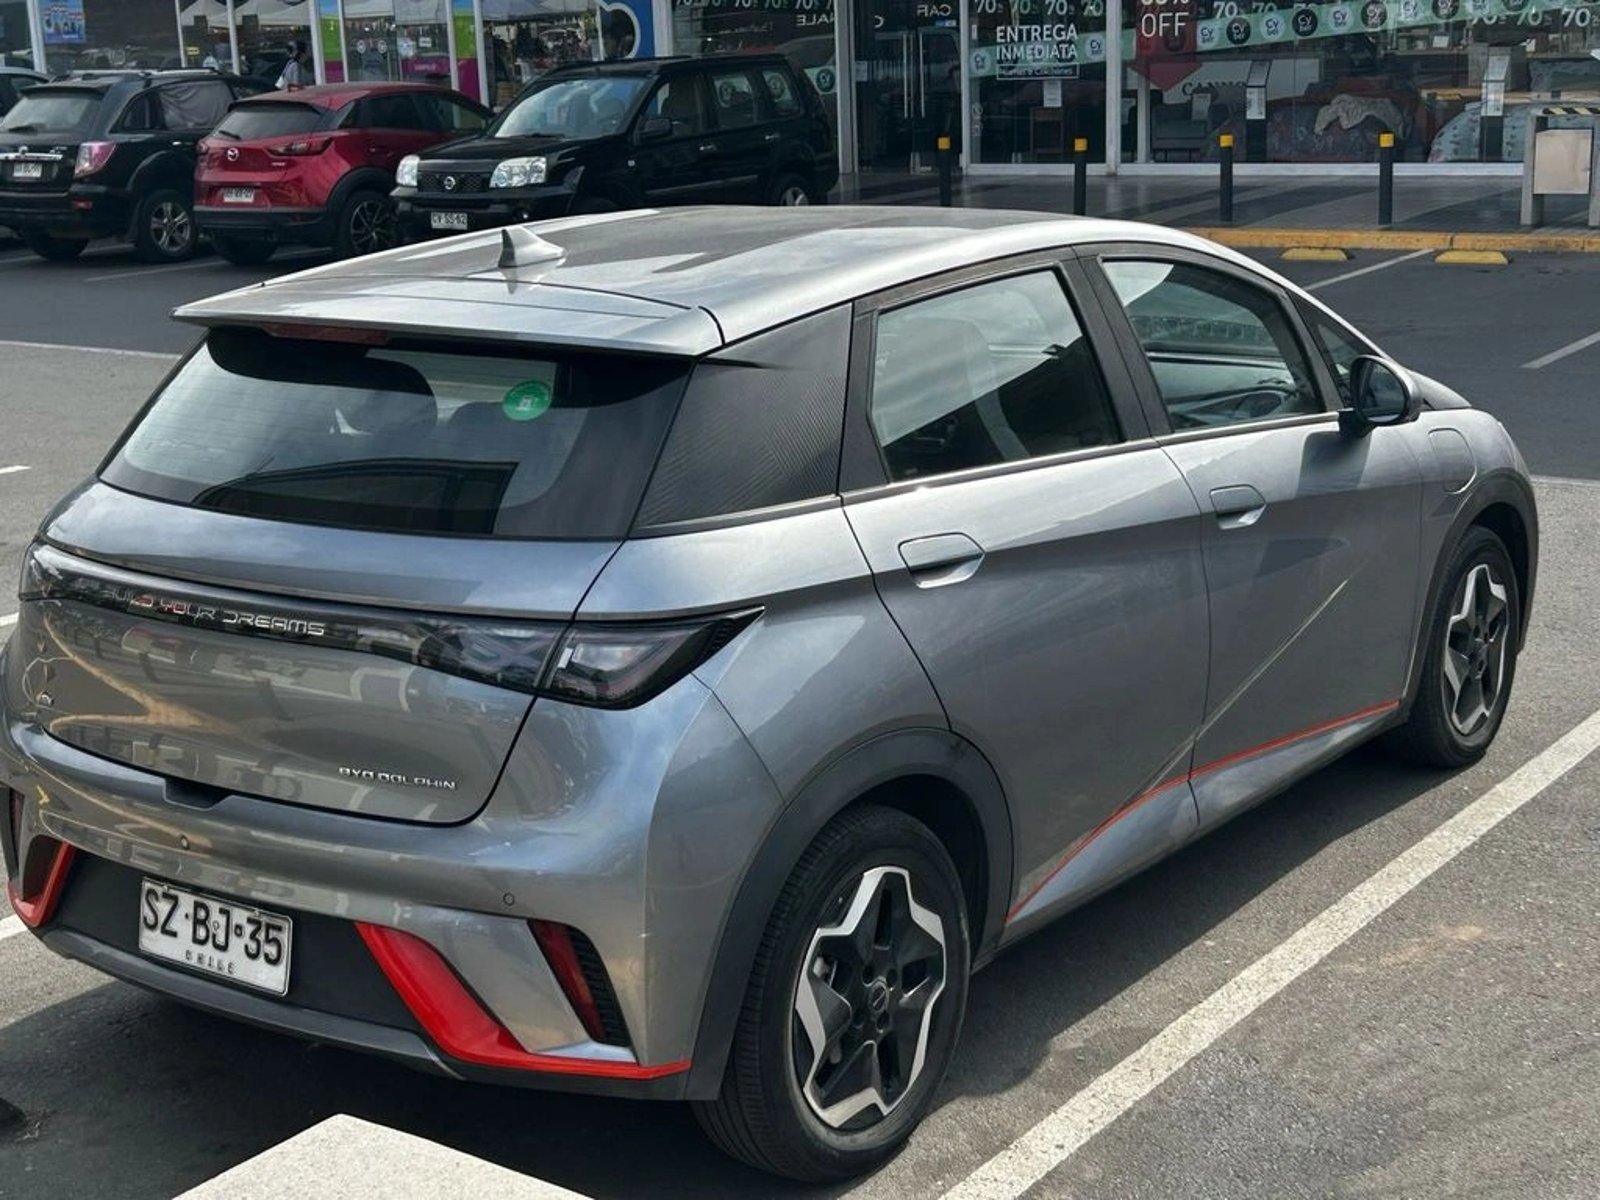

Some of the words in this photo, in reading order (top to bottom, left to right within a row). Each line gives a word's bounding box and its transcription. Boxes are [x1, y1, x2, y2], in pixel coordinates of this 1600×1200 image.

[996, 23, 1078, 42] ENTREGA
[1141, 12, 1189, 37] OFF
[996, 44, 1079, 60] INMEDIATA
[160, 597, 216, 620] YOUR
[222, 610, 326, 636] DREAMS
[338, 766, 374, 780] BYD
[377, 771, 456, 790] DOLPHIN
[185, 949, 235, 974] CHILE
